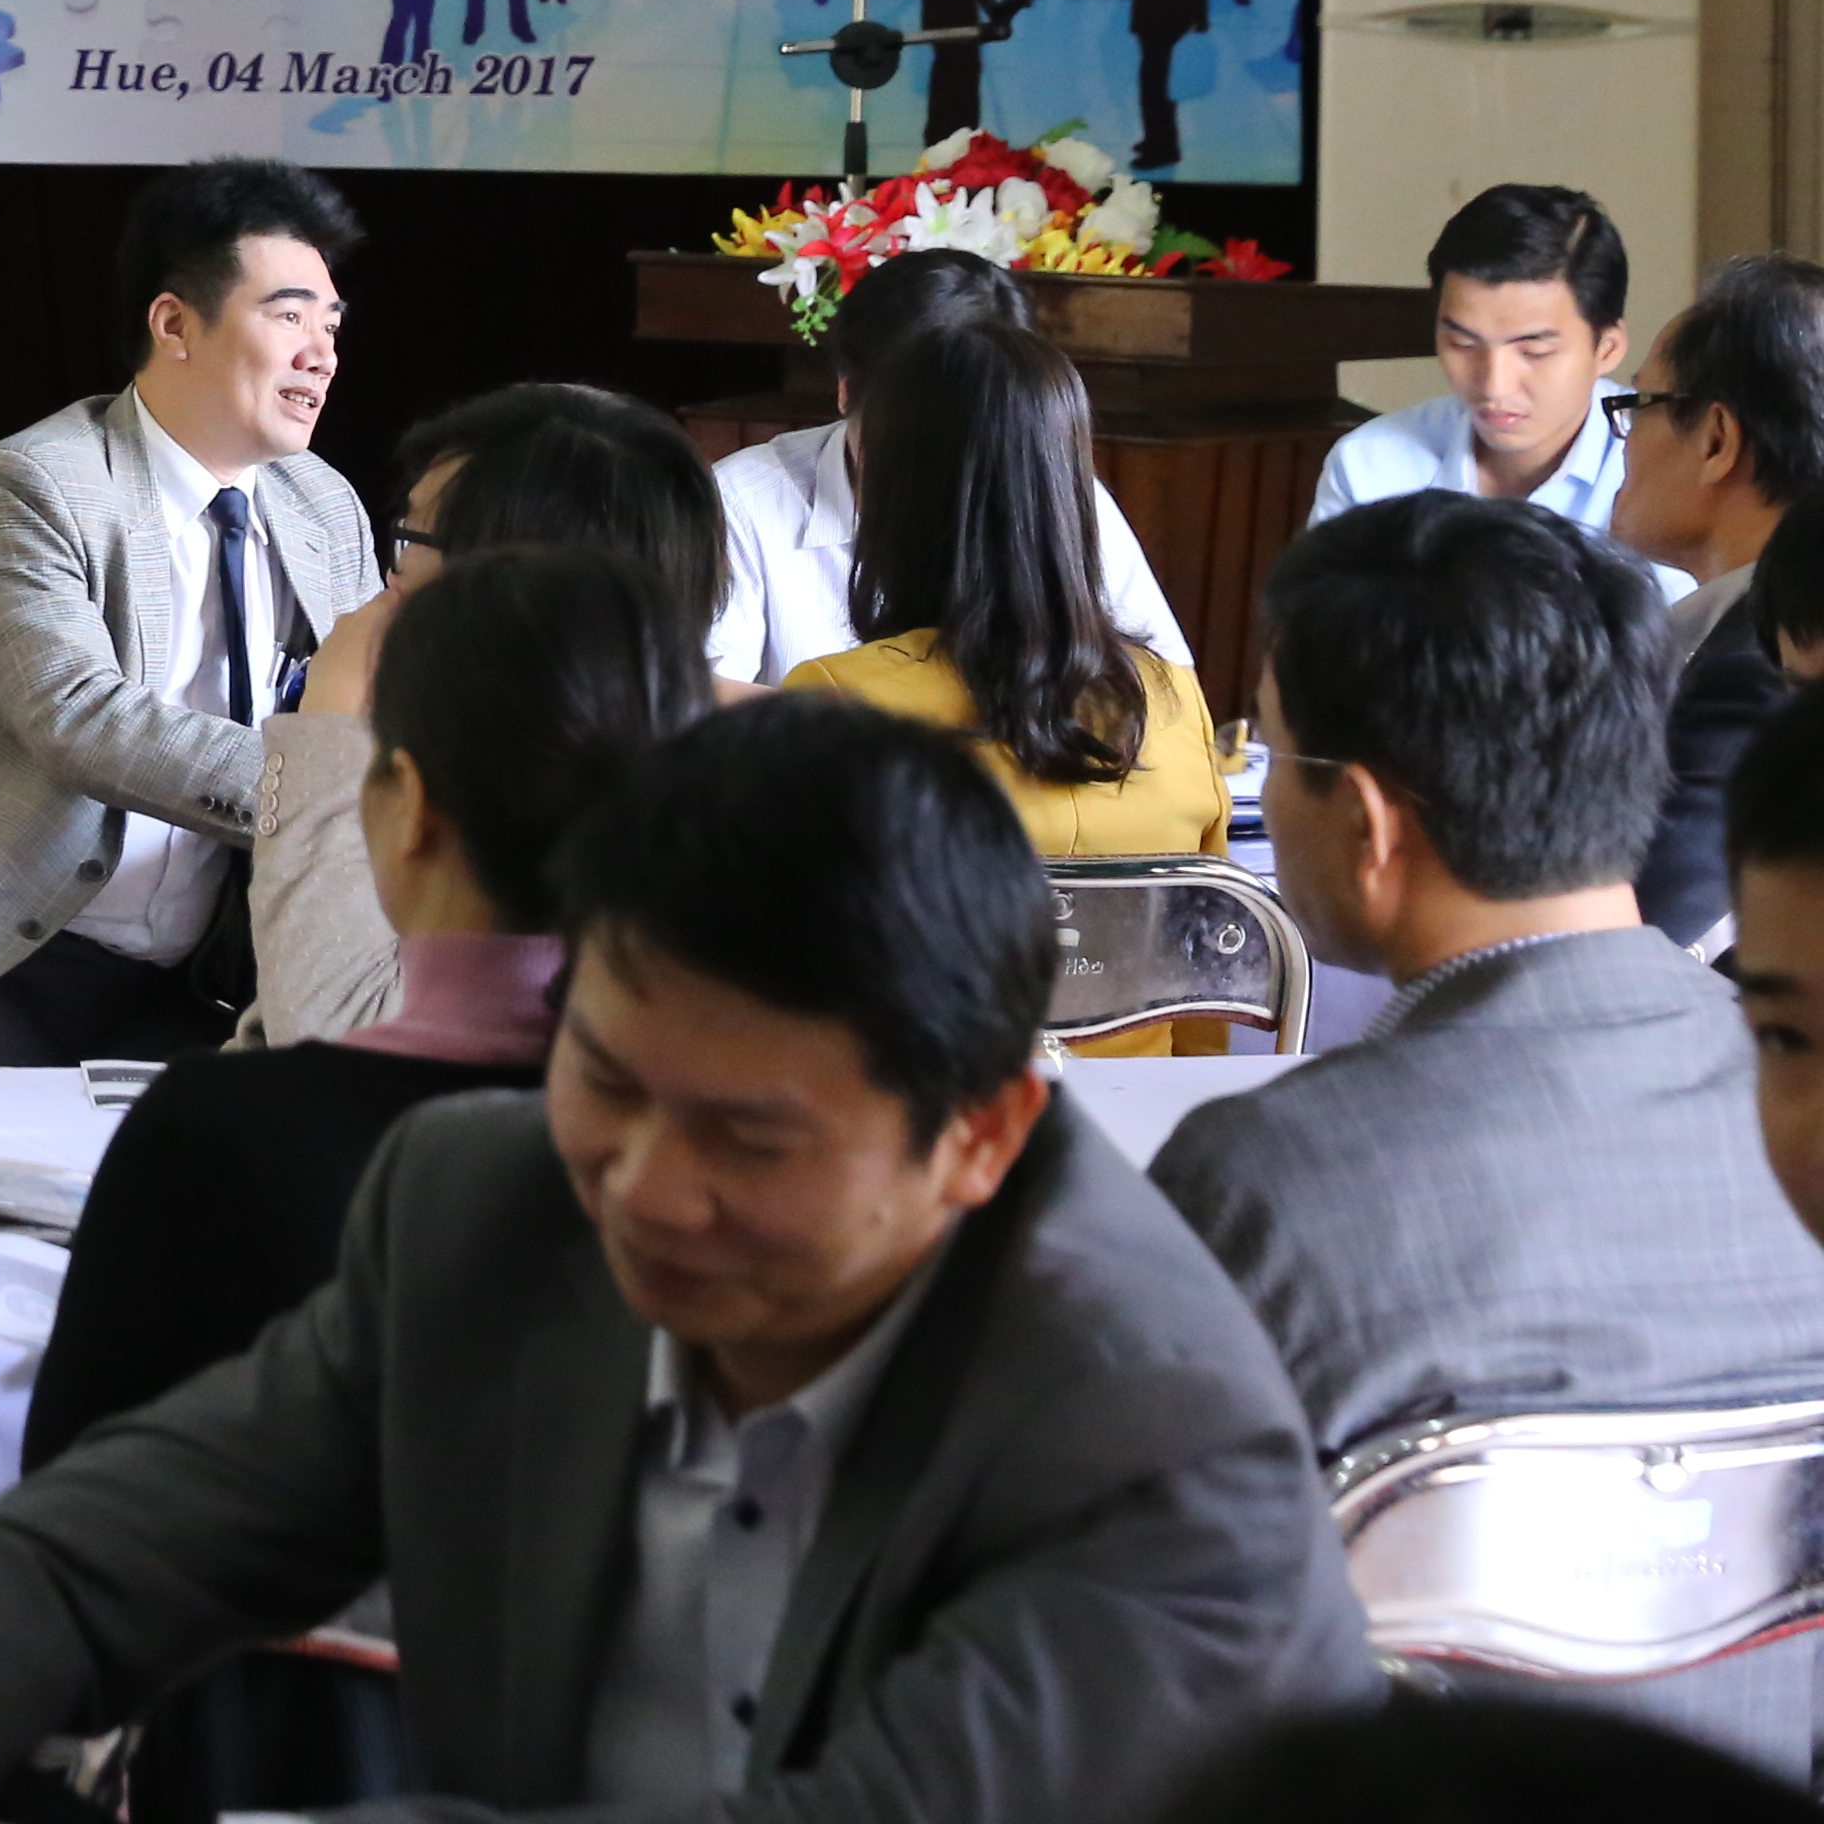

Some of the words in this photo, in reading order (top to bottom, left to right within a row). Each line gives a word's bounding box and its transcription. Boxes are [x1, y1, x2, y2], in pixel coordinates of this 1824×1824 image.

[69, 49, 188, 100] Hue,
[207, 52, 263, 91] 04
[280, 52, 451, 96] March
[470, 54, 595, 96] 2017
